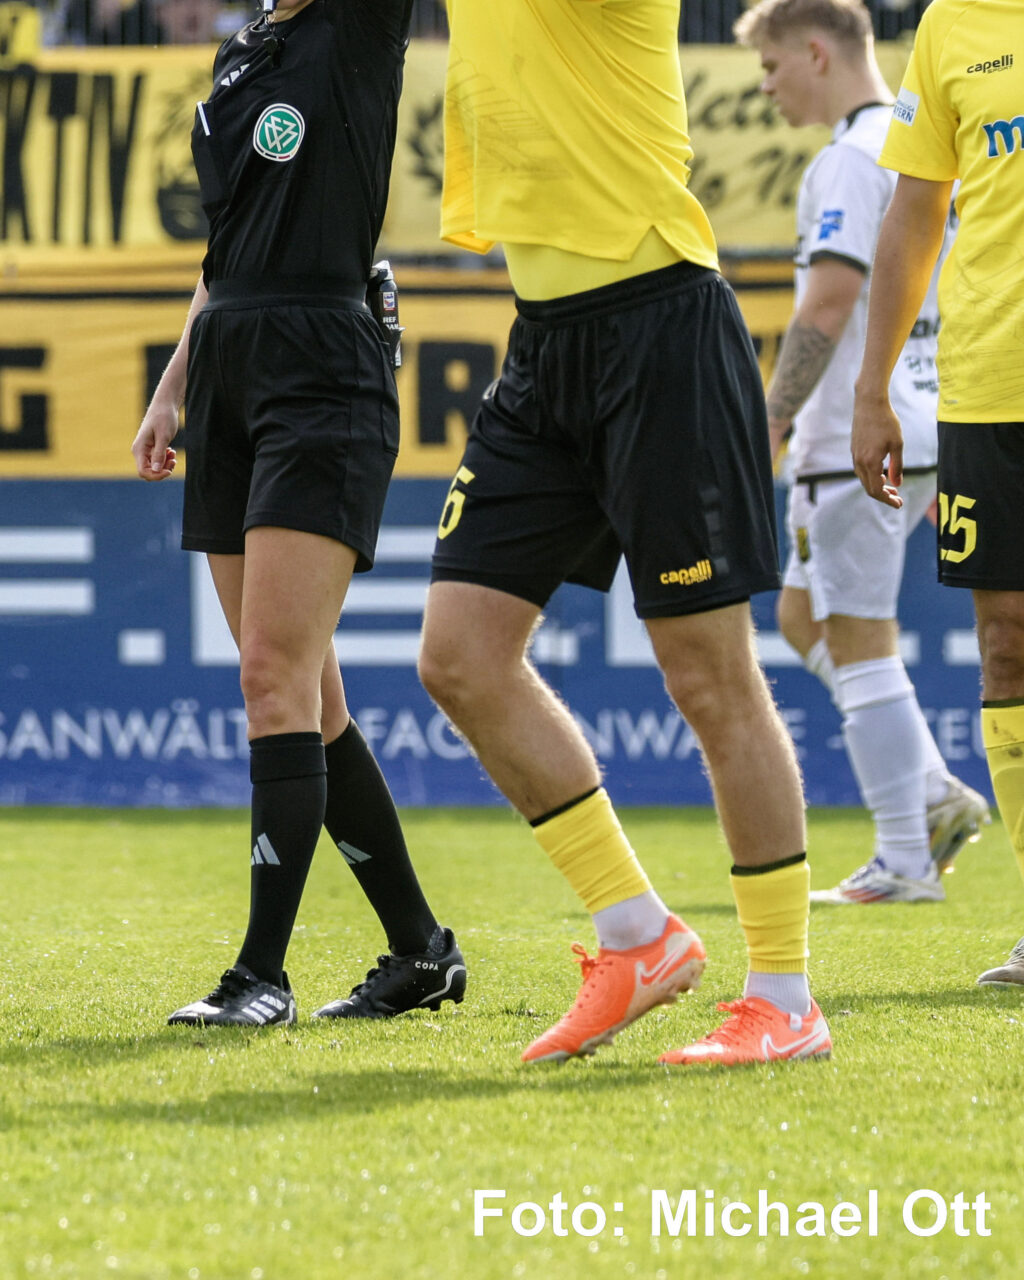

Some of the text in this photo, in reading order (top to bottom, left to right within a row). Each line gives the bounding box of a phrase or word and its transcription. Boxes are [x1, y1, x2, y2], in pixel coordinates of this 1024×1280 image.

[966, 54, 1014, 74] capelli
[659, 558, 713, 586] capelli
[414, 960, 440, 972] COPA
